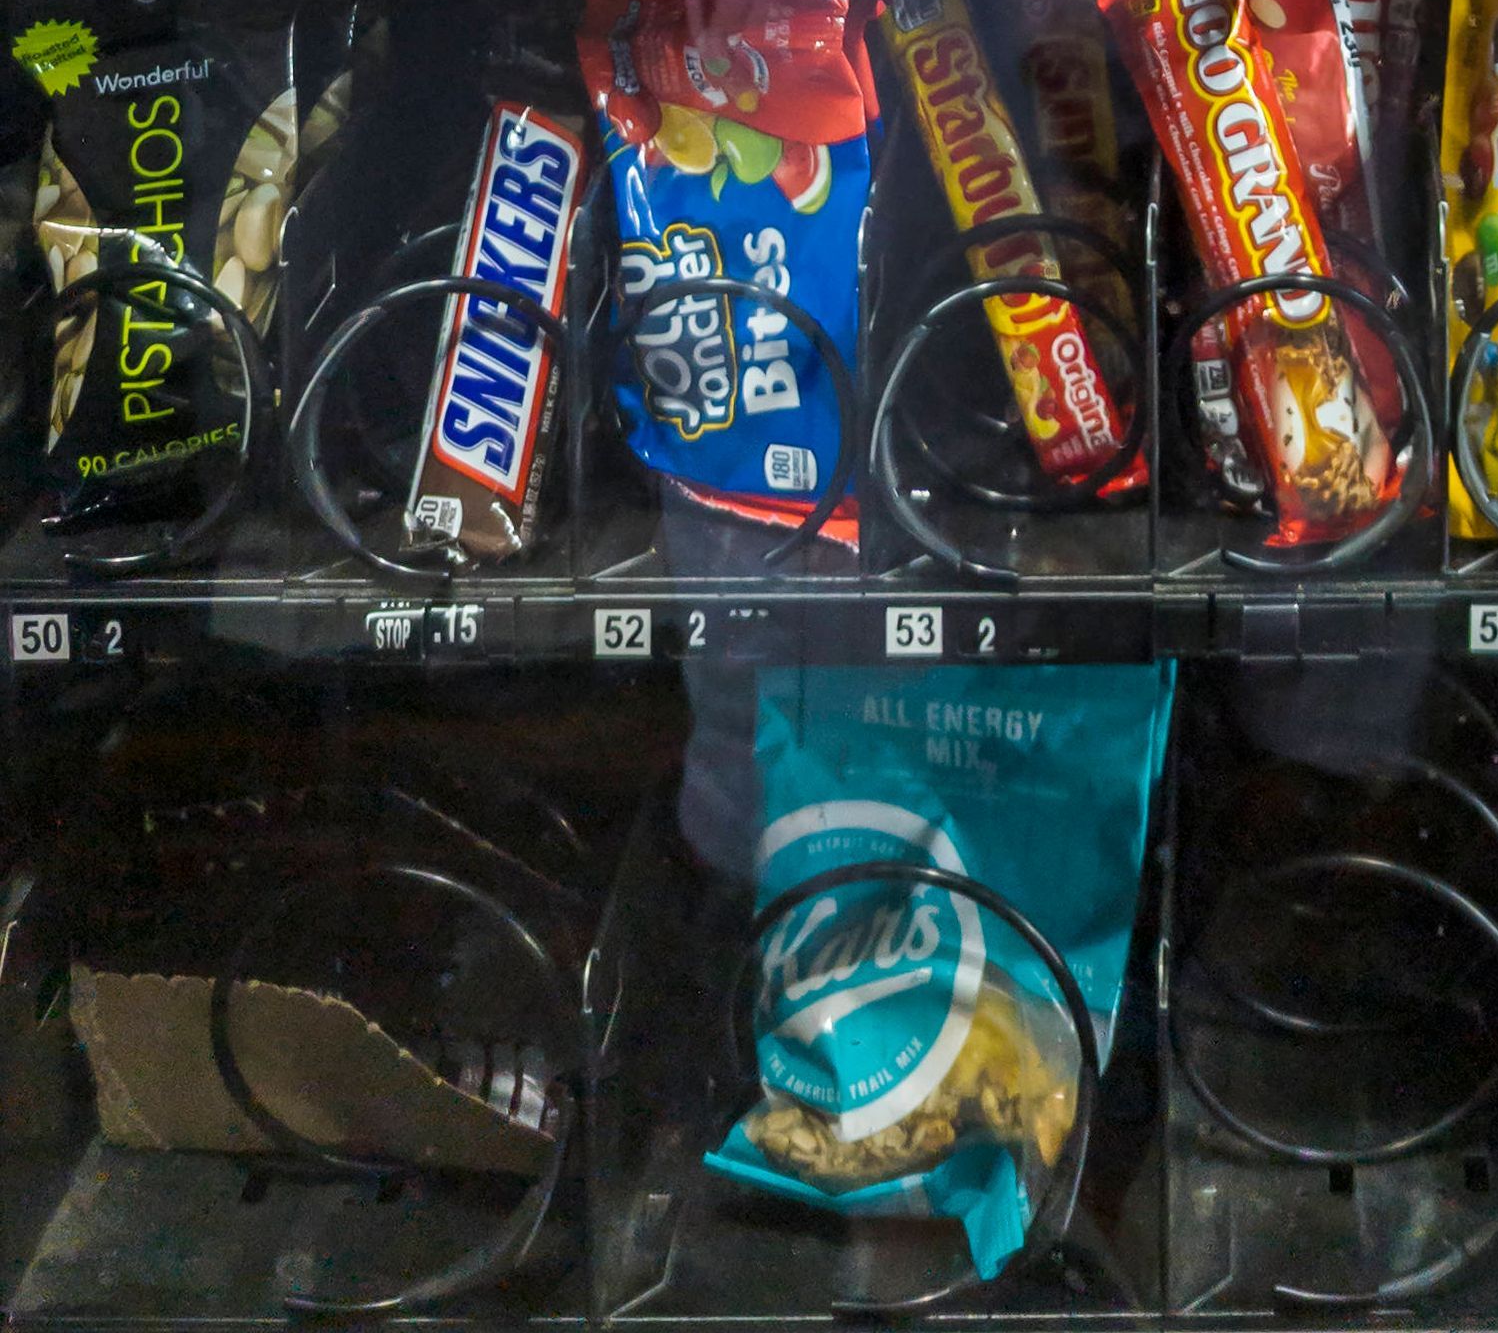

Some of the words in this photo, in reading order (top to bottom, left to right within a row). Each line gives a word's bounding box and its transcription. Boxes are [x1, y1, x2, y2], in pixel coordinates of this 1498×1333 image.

[95, 60, 211, 96] Wonderful
[1216, 99, 1325, 320] GRAND
[120, 94, 185, 423] PISTACHIOS
[442, 116, 573, 475] SNICKERS
[741, 225, 801, 414] Bites
[78, 453, 108, 479] 90
[115, 421, 243, 471] CALORIES
[771, 450, 791, 480] 180
[21, 618, 64, 653] 50
[374, 617, 412, 650] STOP
[604, 616, 644, 647] 52
[895, 613, 937, 648] 53
[864, 695, 911, 729] ALL
[925, 701, 1044, 742] ENERGY
[925, 737, 984, 768] MIX
[848, 1065, 894, 1102] TRAIL
